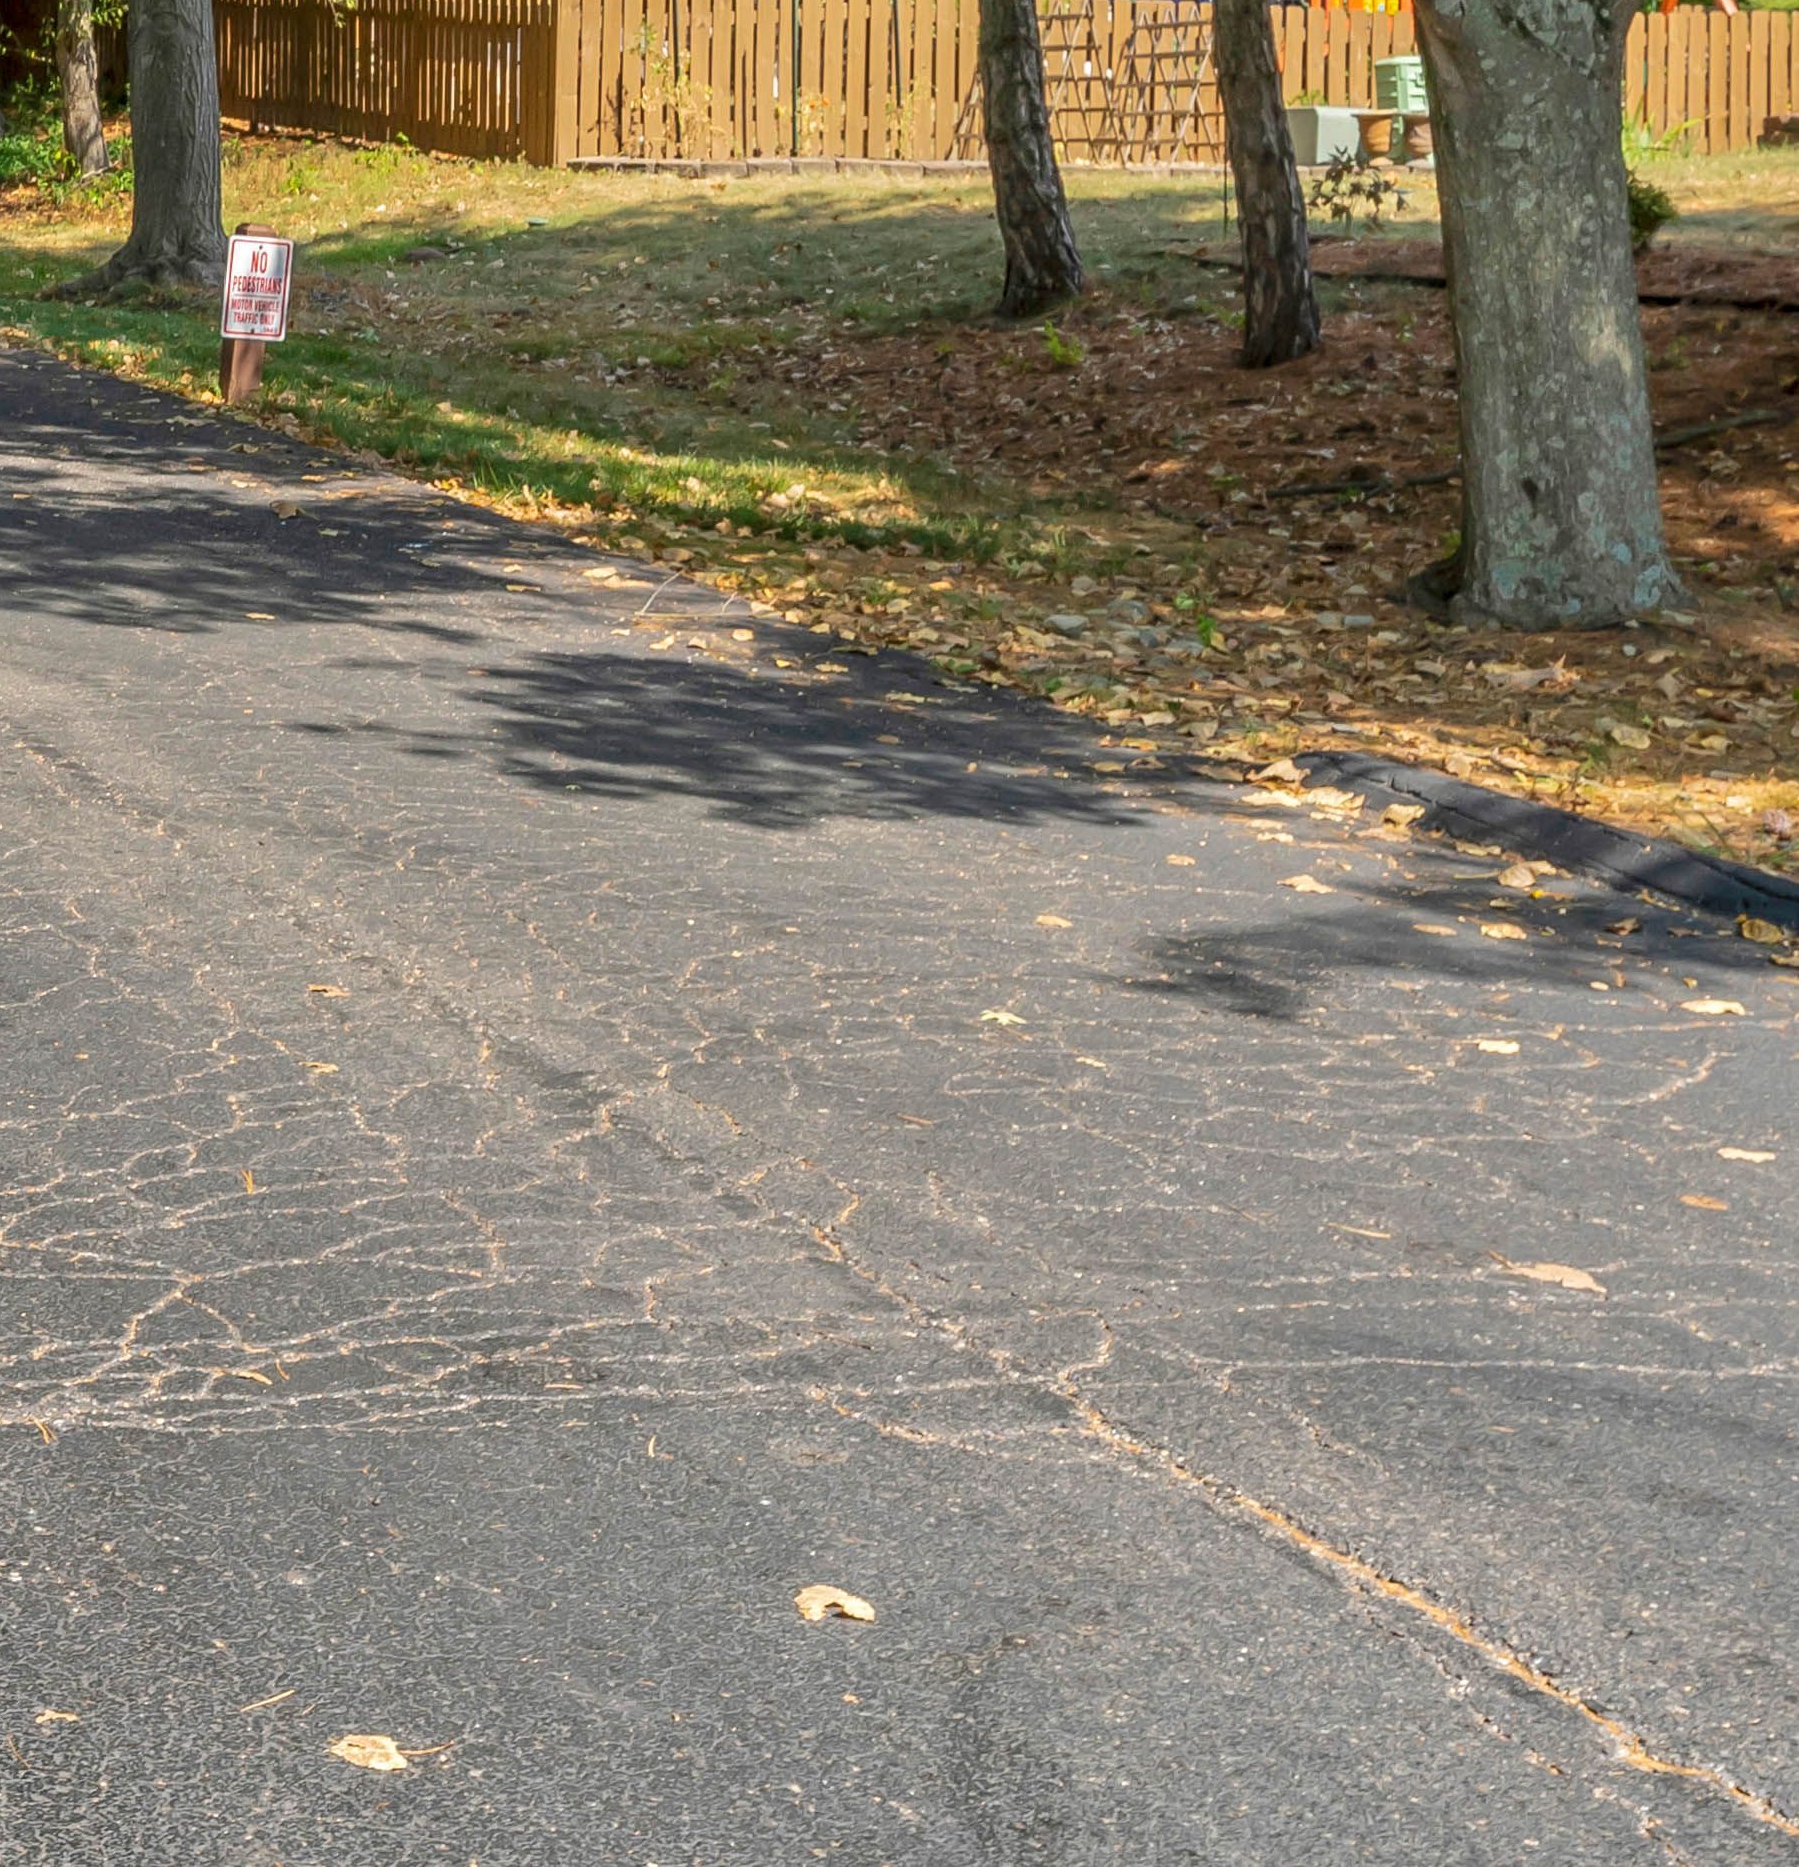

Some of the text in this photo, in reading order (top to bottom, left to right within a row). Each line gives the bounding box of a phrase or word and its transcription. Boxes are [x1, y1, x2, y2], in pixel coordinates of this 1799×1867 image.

[251, 251, 268, 274] NO
[232, 276, 282, 294] PEDESTRIANS
[231, 298, 279, 313] MOTOR VEHICLE
[233, 312, 258, 325] TRAFFIC
